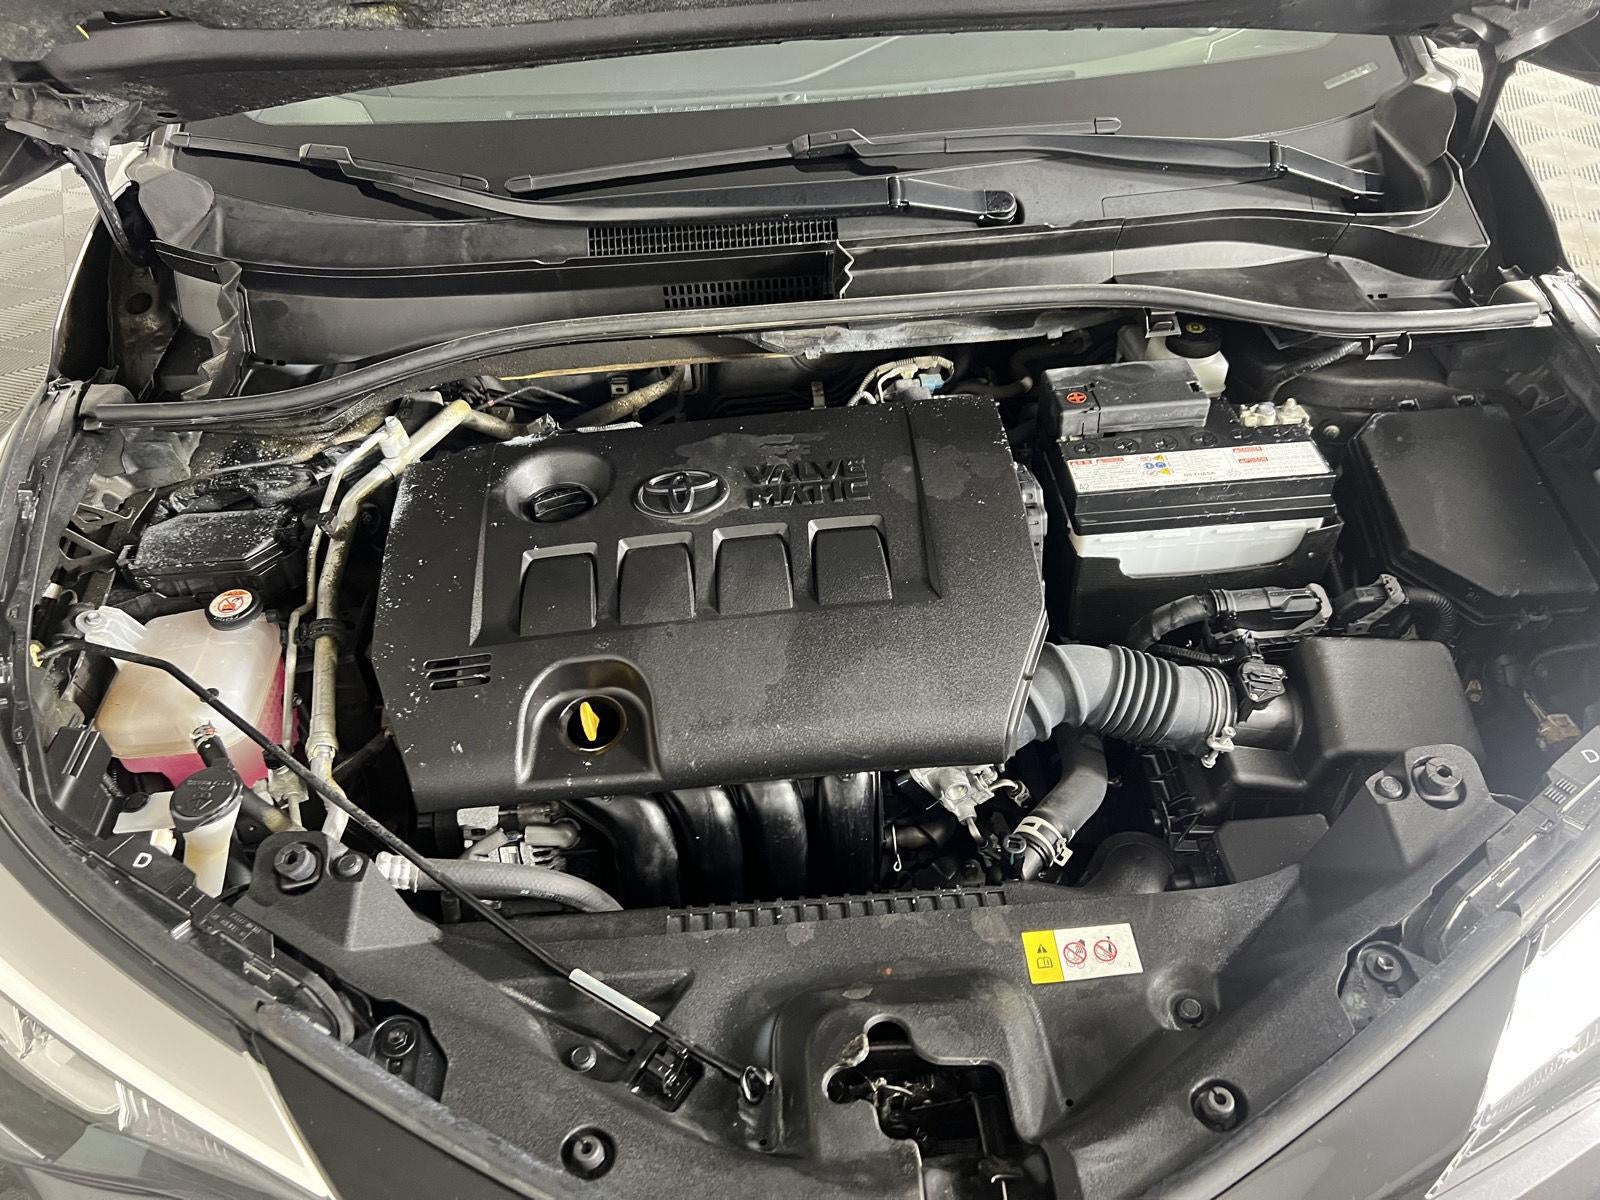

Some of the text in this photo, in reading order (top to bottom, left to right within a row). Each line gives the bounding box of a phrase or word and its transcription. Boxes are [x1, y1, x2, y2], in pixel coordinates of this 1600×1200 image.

[744, 456, 868, 484] VALVE
[747, 481, 872, 510] MATIC
[1580, 749, 1600, 764] D
[132, 851, 153, 869] D
